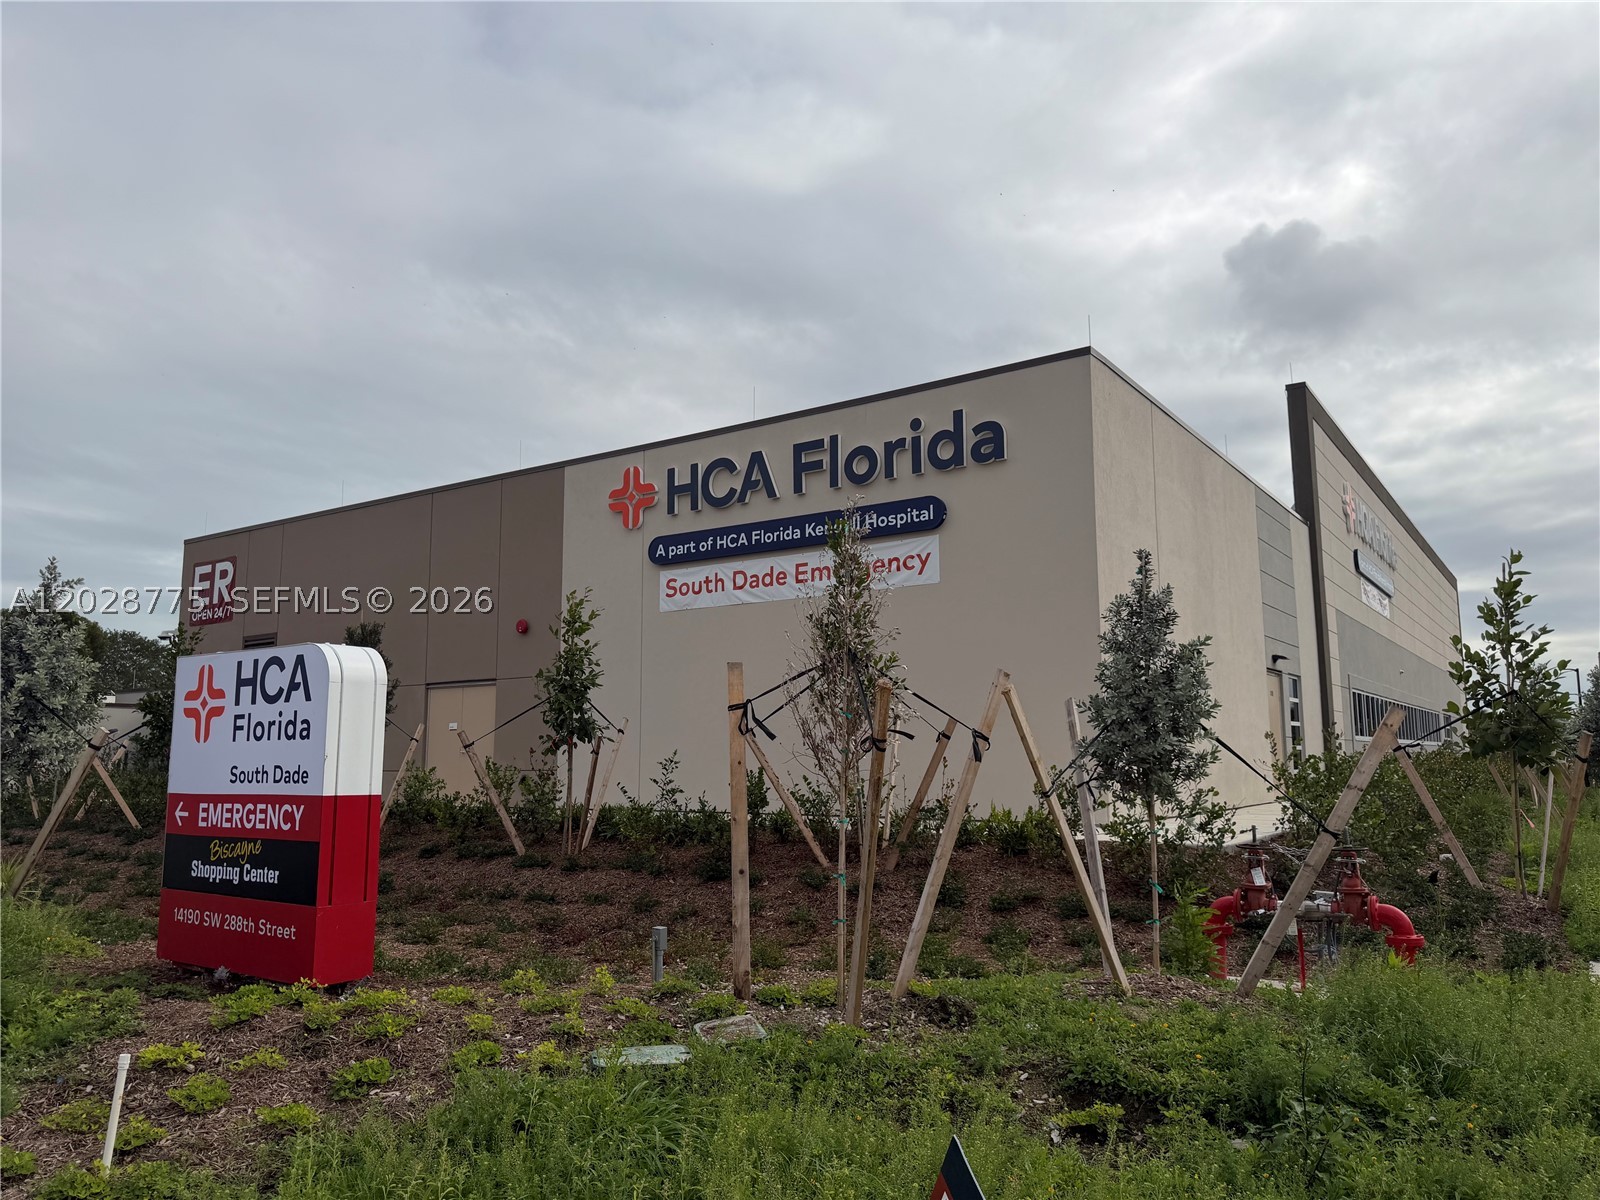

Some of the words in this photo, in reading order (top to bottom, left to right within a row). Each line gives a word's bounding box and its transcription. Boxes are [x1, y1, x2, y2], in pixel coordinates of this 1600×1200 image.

[666, 450, 781, 516] HCA
[793, 409, 1008, 496] Florida
[655, 544, 666, 558] A
[668, 541, 696, 559] part
[699, 537, 714, 551] of
[716, 532, 749, 549] HCA
[752, 525, 801, 545] Florida
[805, 514, 861, 537] Kell
[865, 504, 934, 529] Hospital
[192, 561, 234, 608] ER
[665, 572, 725, 598] South
[732, 566, 788, 590] Dade
[795, 552, 931, 584] Emency
[191, 608, 213, 621] OPEN
[213, 605, 233, 618] 24/7
[234, 654, 312, 706] HCA
[232, 710, 311, 742] Florida
[229, 765, 269, 784] South
[273, 765, 309, 784] Dade
[198, 803, 304, 830] EMERGENCY
[210, 840, 262, 864] Biscayne
[191, 860, 240, 884] Shopping
[243, 863, 279, 884] Center
[174, 907, 200, 925] 14190
[203, 911, 222, 928] SW
[224, 914, 255, 933] 288th
[258, 919, 296, 940] Street
